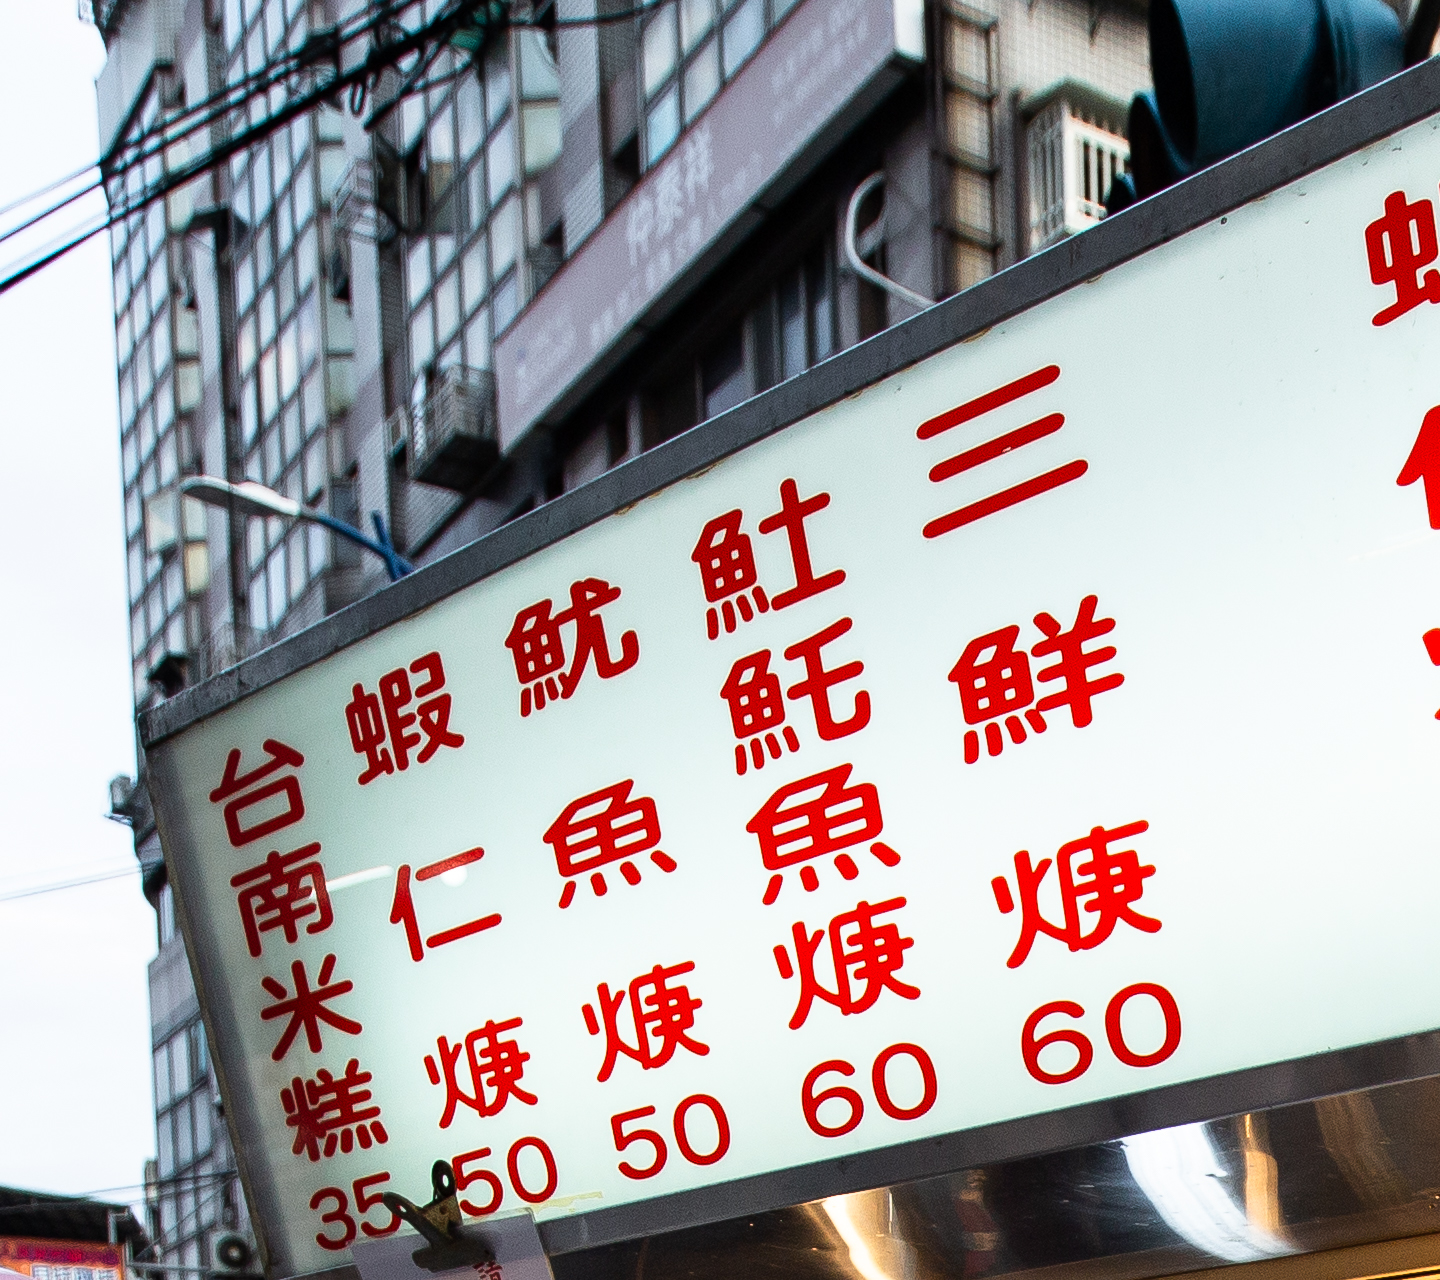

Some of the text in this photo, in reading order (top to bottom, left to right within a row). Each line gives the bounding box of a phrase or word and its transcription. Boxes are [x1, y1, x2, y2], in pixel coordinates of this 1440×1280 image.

[917, 365, 1162, 969] 三鮮焿
[506, 579, 710, 1083] 魷魚焿
[347, 653, 538, 1129] 蝦仁焿
[211, 740, 389, 1160] 台南米糕
[1021, 983, 1181, 1085] 60
[611, 1094, 730, 1180] 50
[802, 1043, 937, 1138] 60
[310, 1172, 402, 1250] 35
[452, 1137, 557, 1217] 50
